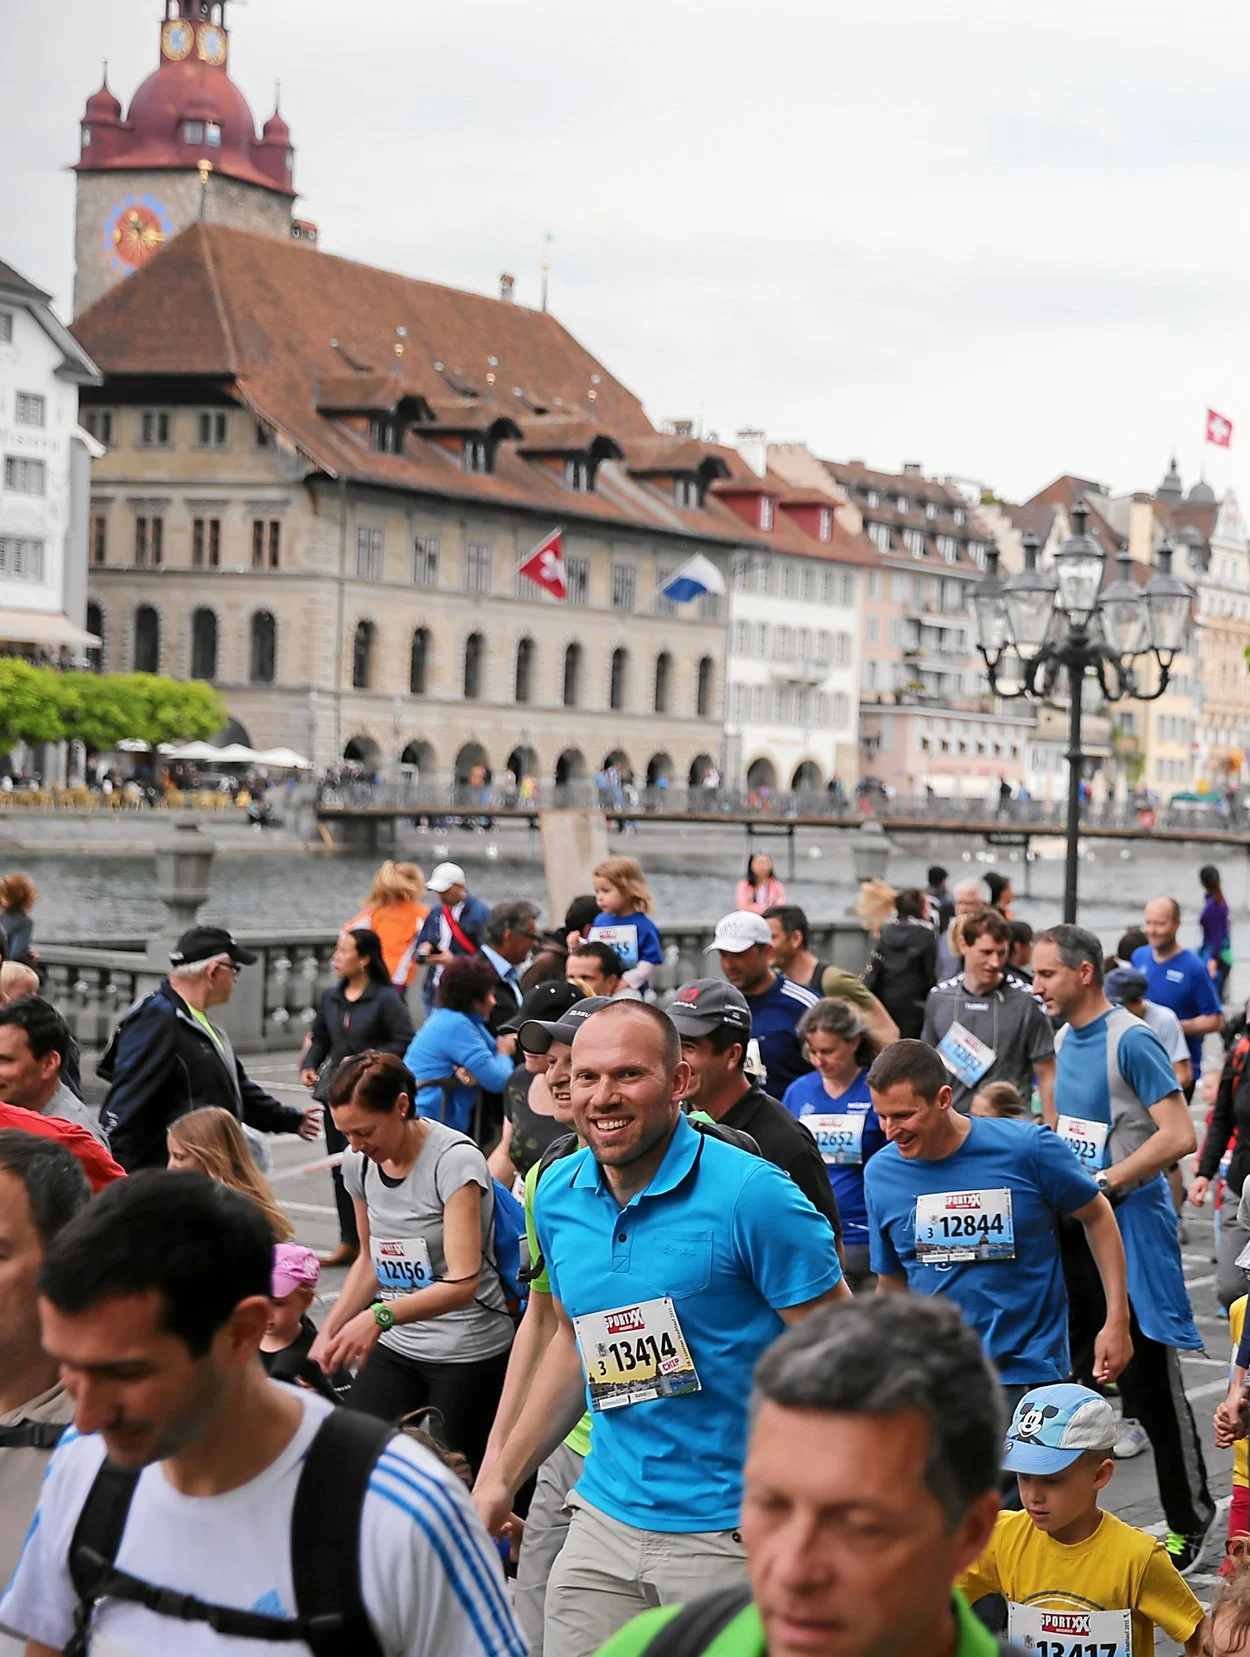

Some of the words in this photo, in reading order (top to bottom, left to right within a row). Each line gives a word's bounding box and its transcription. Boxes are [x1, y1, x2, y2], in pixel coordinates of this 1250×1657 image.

[815, 1131, 854, 1146] 12652
[1064, 1137, 1096, 1159] 923
[927, 1227, 934, 1239] 3
[939, 1213, 1004, 1238] 12844
[381, 1260, 425, 1280] 12156
[604, 1308, 646, 1328] SPORTXX
[599, 1360, 607, 1376] 3
[609, 1332, 677, 1372] 13414
[662, 1358, 680, 1372] CHIP
[1040, 1614, 1091, 1632] SPORTXX
